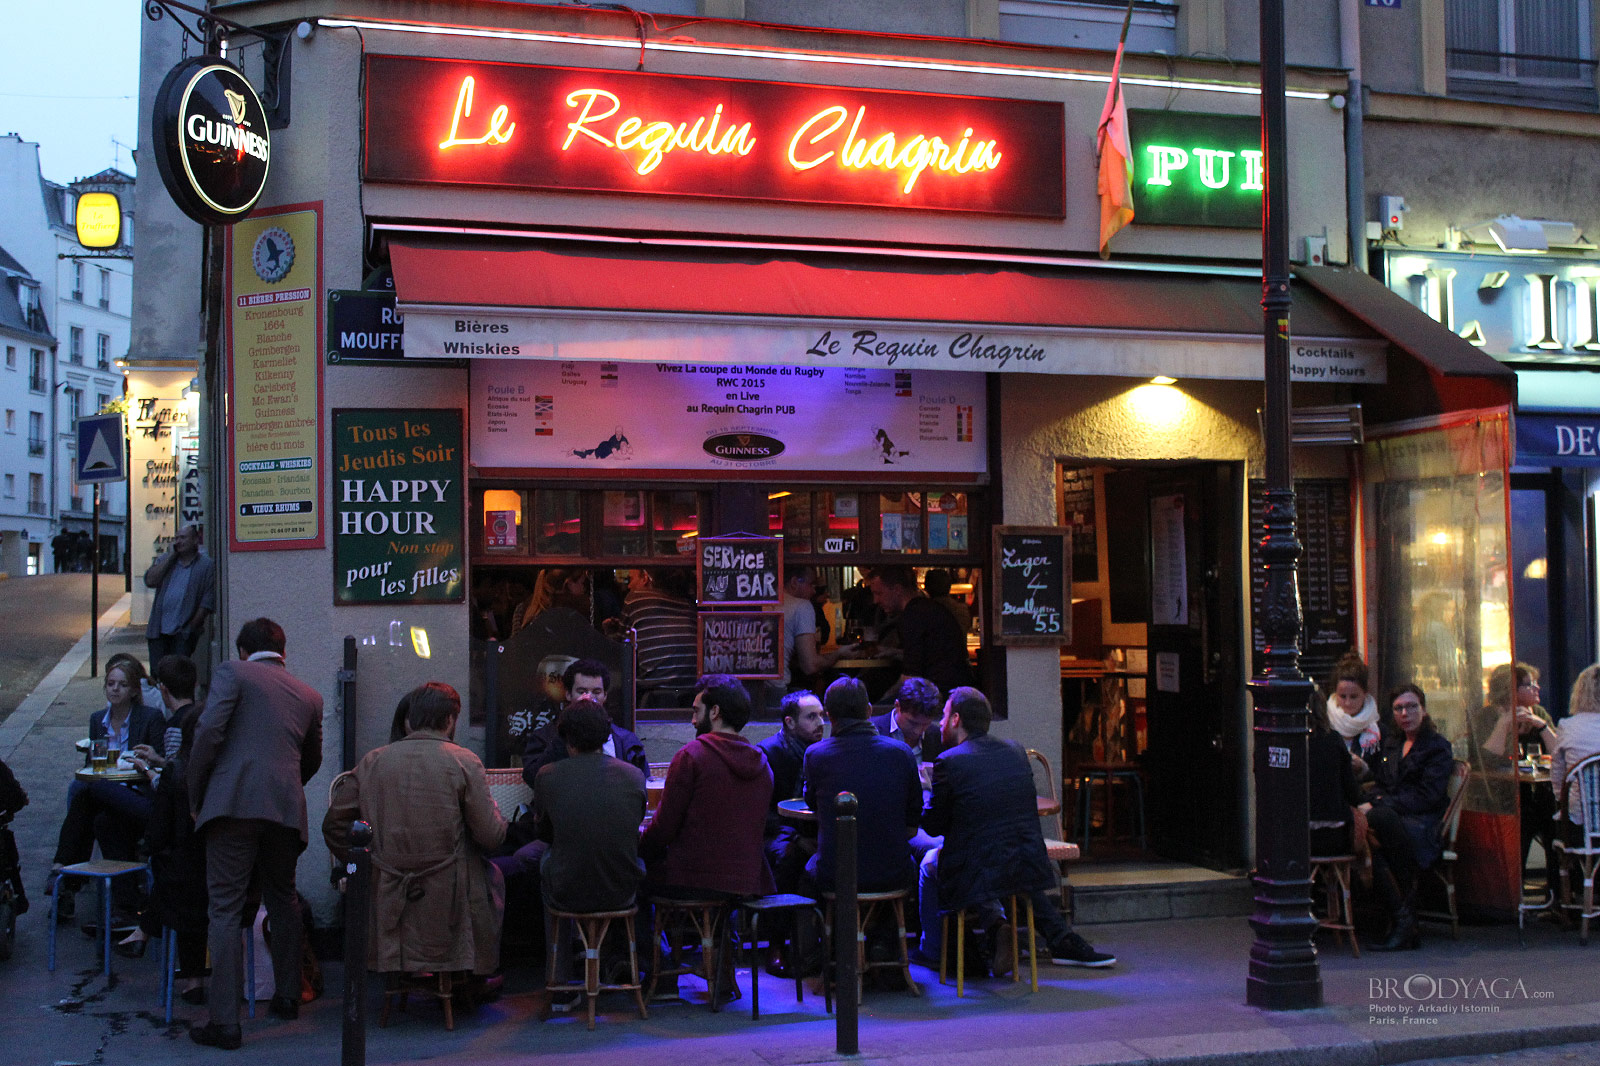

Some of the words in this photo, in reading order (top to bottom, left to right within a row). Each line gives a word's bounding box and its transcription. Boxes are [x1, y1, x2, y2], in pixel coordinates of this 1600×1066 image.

[187, 114, 268, 162] GUINNESS
[439, 75, 516, 150] Le
[561, 88, 756, 175] Requin
[788, 105, 1002, 195] Chagrin
[239, 298, 246, 306] 11
[275, 289, 310, 302] PRESSION
[245, 306, 304, 320] Kronenbourg
[263, 320, 285, 331] 1664
[454, 319, 509, 334] Bières
[257, 332, 292, 343] Blanche
[340, 331, 404, 350] MOUFF
[248, 344, 300, 357] Grimbergen
[443, 341, 520, 355] Whiskies
[806, 330, 841, 357] Le
[852, 330, 940, 365] Requin
[948, 332, 1046, 369] Chagrin
[1296, 346, 1354, 359] Cocktails
[253, 357, 297, 369] Karmeliet
[255, 370, 295, 381] Kilkenny
[656, 363, 683, 373] Vivez
[685, 364, 697, 373] La
[699, 365, 728, 376] coupe
[730, 365, 743, 374] du
[745, 365, 778, 375] Monde
[779, 366, 792, 375] du
[794, 367, 825, 378] Rugby
[1330, 365, 1366, 376] Hours
[254, 381, 297, 393] Carlsberg
[487, 385, 515, 394] Poule
[561, 379, 588, 387] Uruguay
[716, 378, 739, 387] RWC
[741, 378, 766, 388] 2015
[725, 392, 738, 400] en
[740, 391, 760, 401] Live
[919, 395, 947, 404] Poule
[255, 407, 296, 418] Guinness
[686, 405, 699, 413] au
[701, 404, 735, 415] Requin
[737, 404, 773, 416] Chagrin
[775, 405, 796, 414] PUB
[236, 420, 283, 432] Grimbergen
[347, 424, 398, 444] Tous
[403, 421, 431, 438] les
[246, 442, 269, 453] bière
[270, 441, 282, 450] du
[284, 440, 305, 450] mois
[1555, 424, 1600, 456] DE
[715, 445, 771, 455] GUINNESS
[339, 449, 406, 472] Jeudis
[412, 444, 455, 464] Soir
[240, 461, 275, 471] COCKTAILS
[279, 459, 312, 469] WHISKIES
[241, 488, 274, 498] Canadien
[280, 487, 311, 496] Bourbon
[340, 479, 451, 503] HAPPY
[252, 504, 274, 514] VIEUX
[275, 502, 300, 512] RHUMS
[339, 511, 437, 535] HOUR
[387, 541, 419, 554] Non
[424, 542, 454, 557] stop
[1001, 547, 1052, 577] Lager
[346, 561, 392, 588] pour
[380, 577, 406, 597] les
[410, 566, 458, 595] filles
[736, 572, 777, 598] BAR
[1027, 573, 1047, 598] 4
